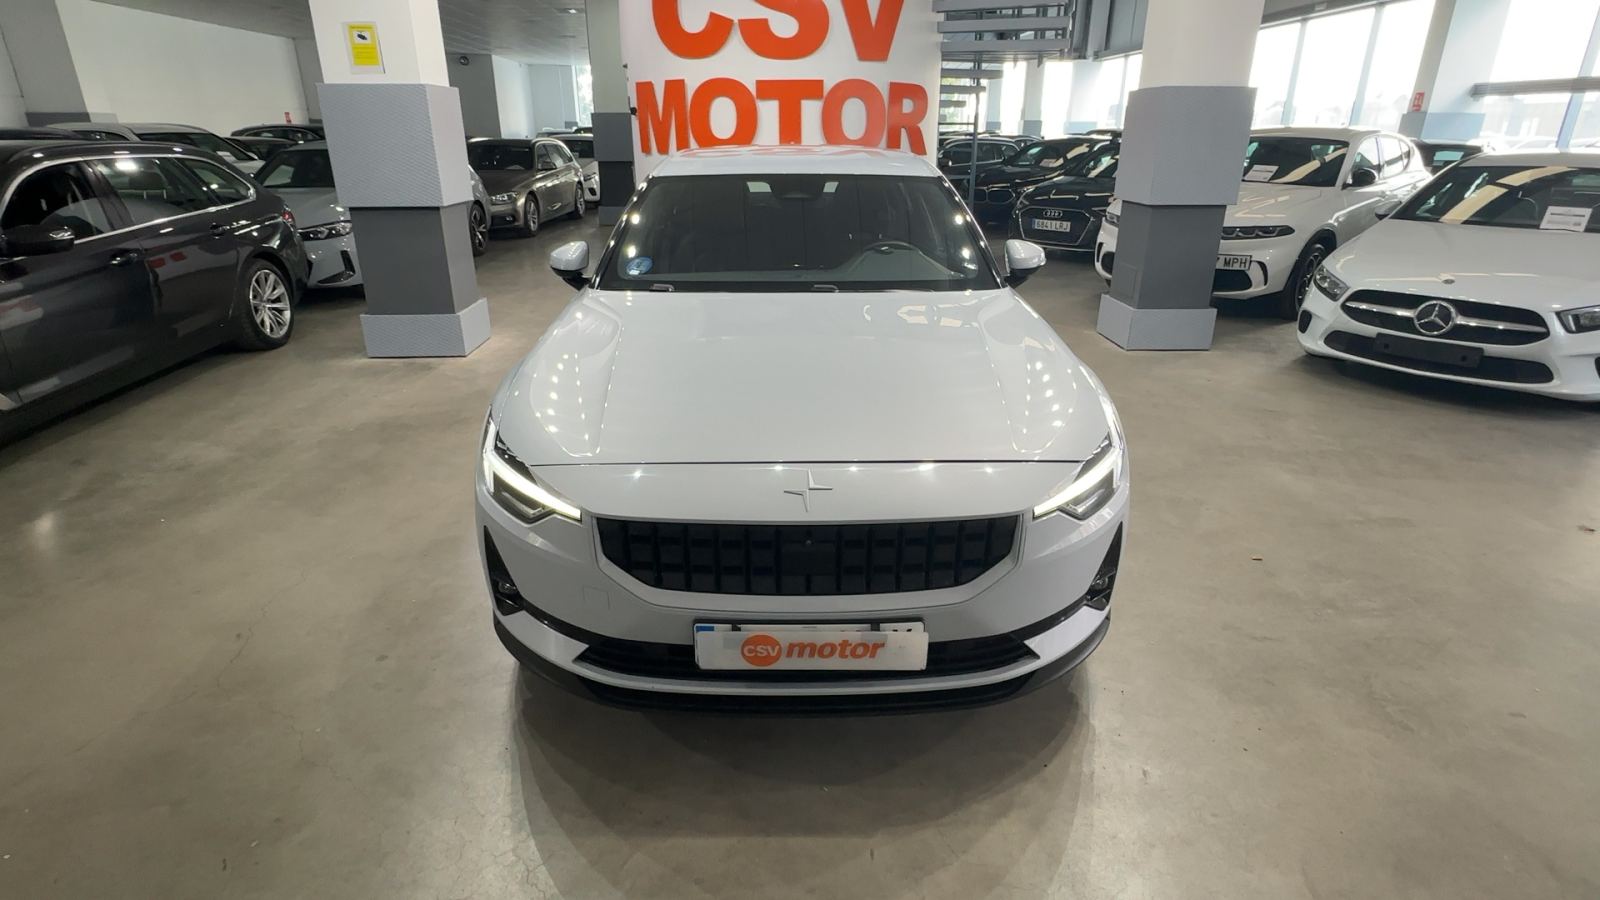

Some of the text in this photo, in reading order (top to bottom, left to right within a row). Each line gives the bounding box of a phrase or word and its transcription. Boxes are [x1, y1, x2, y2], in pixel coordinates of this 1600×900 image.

[653, 0, 904, 61] CSV
[636, 77, 928, 155] MOTOR
[1223, 257, 1248, 268] MPH
[743, 639, 886, 660] CSV motor
